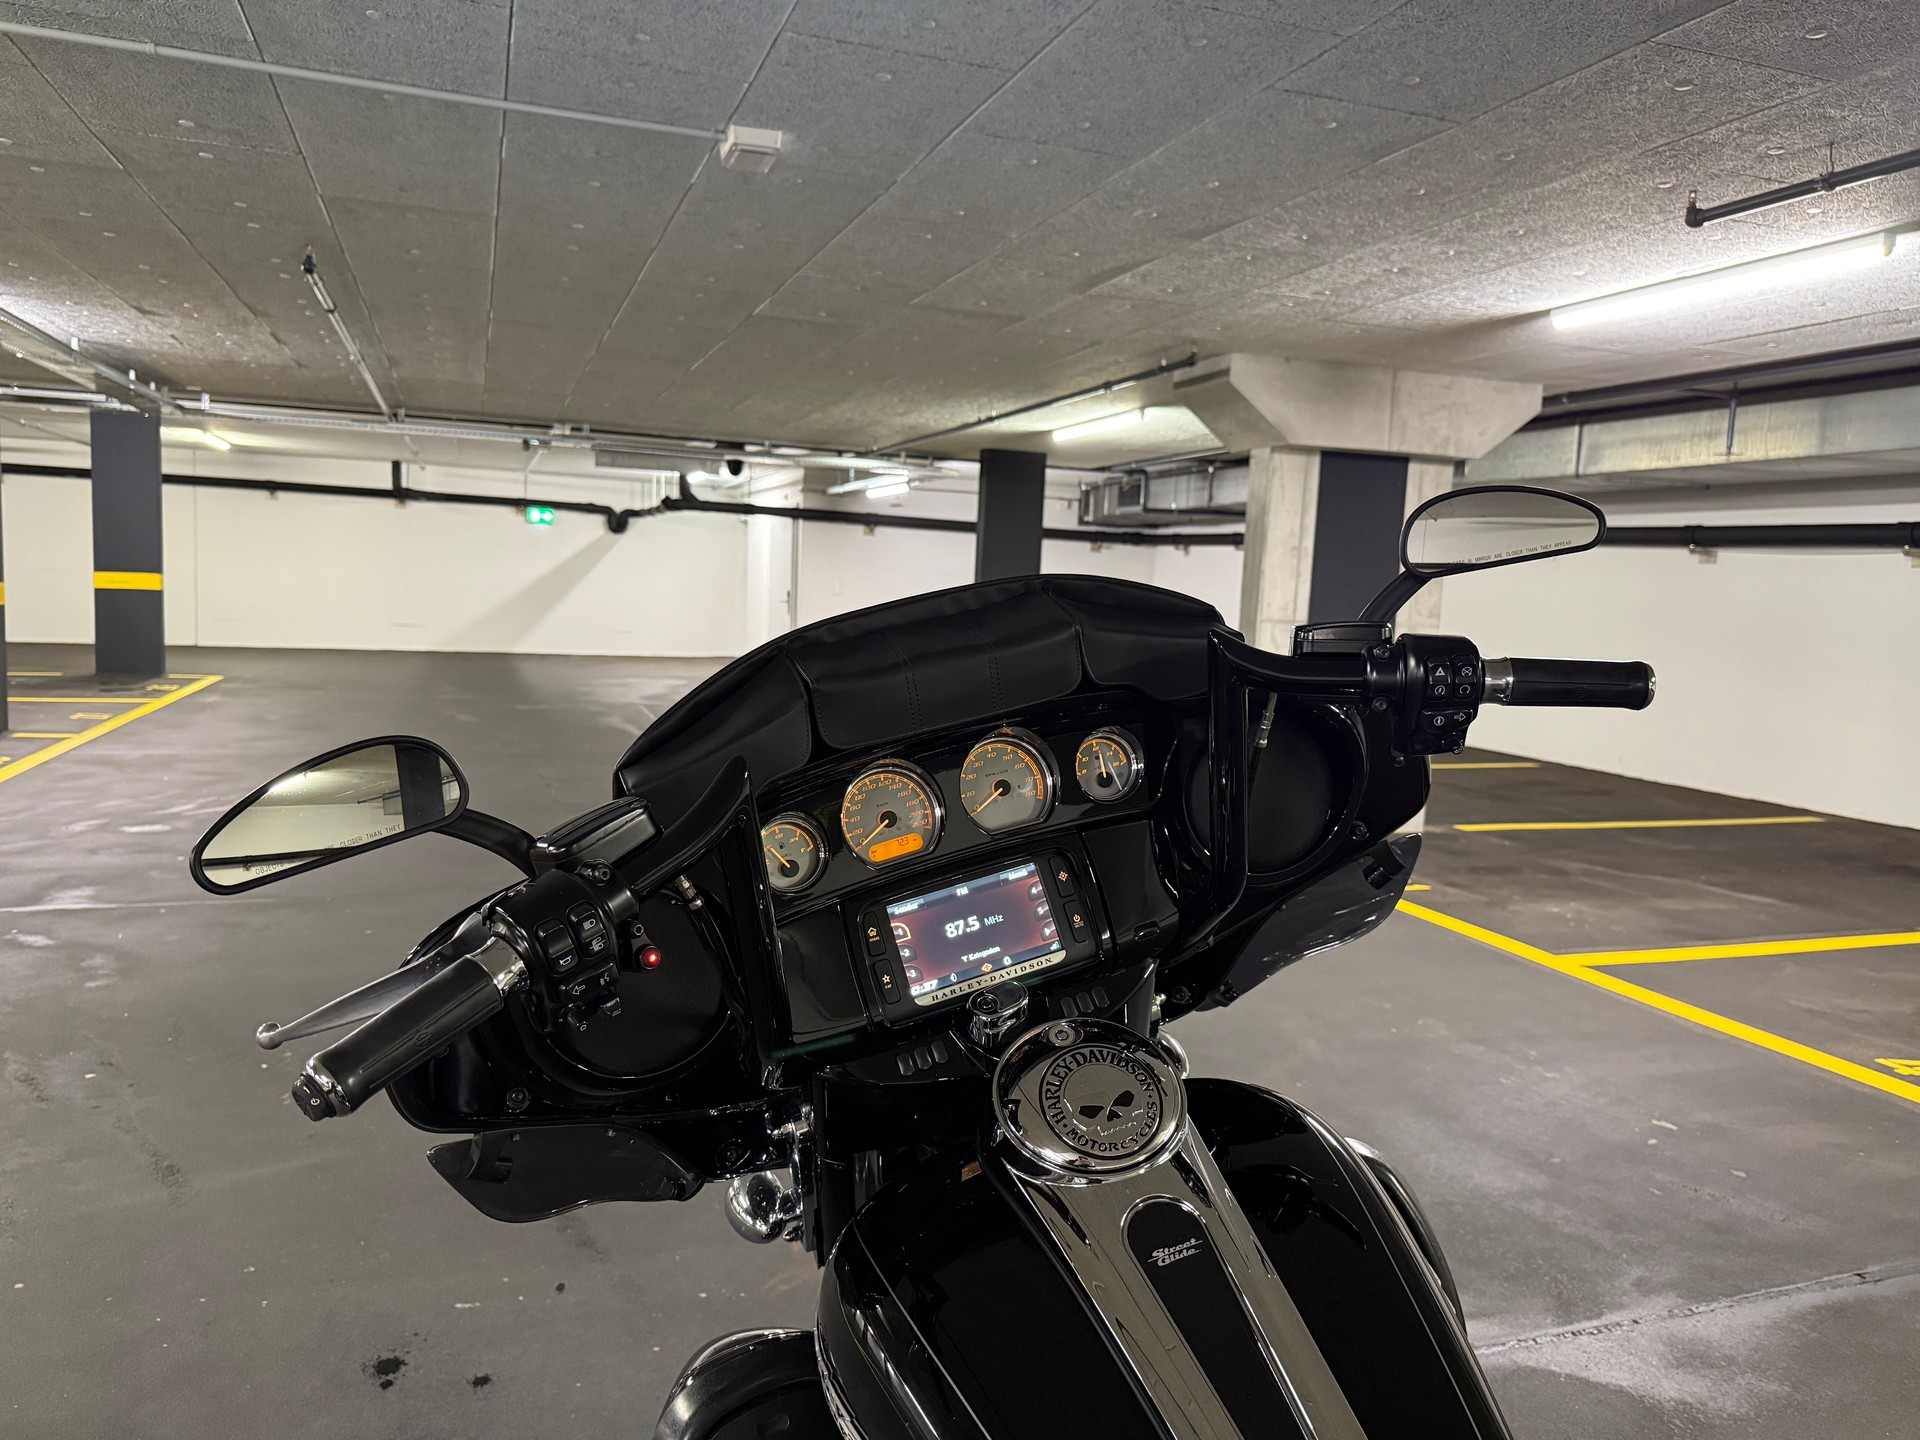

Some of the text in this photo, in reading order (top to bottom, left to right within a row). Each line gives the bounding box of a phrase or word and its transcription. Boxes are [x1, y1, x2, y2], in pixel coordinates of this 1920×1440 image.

[1505, 549, 1524, 558] CLOSER
[1554, 540, 1572, 549] APPEAR
[862, 783, 876, 792] 100
[339, 835, 363, 849] CLOSER
[365, 830, 382, 840] THAN
[385, 824, 401, 834] THEY
[956, 886, 969, 897] FM
[894, 902, 919, 915] Sender
[945, 914, 1004, 938] 87.5 MHz
[931, 956, 1054, 1002] HARLEY-DAVIDSON
[1045, 1049, 1154, 1126] HARLEY-DAVIDSON
[1065, 1101, 1158, 1152] MOTORCYCLES
[1148, 1238, 1202, 1262] Street
[1157, 1248, 1201, 1267] Glide
